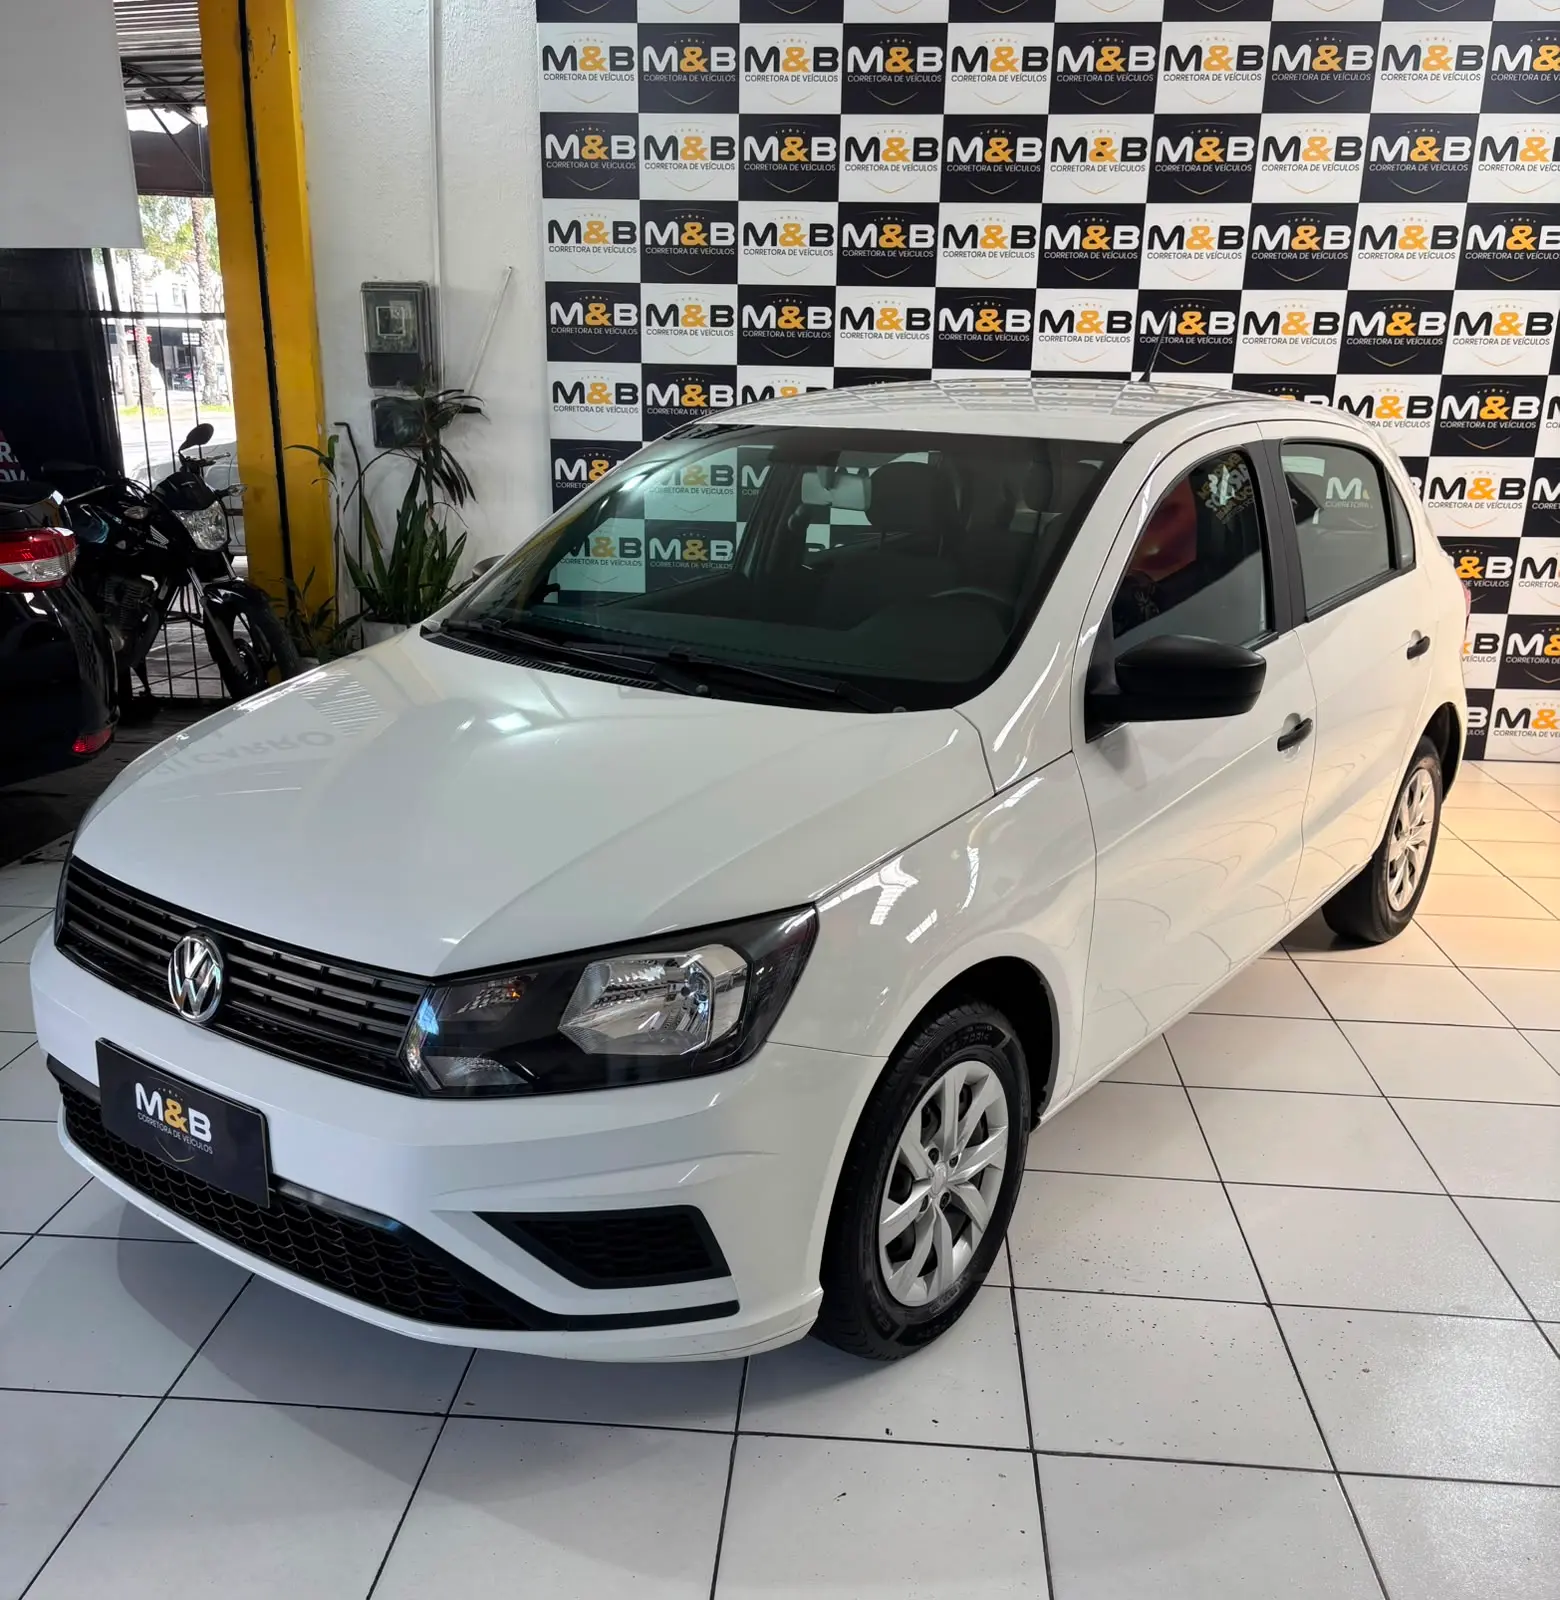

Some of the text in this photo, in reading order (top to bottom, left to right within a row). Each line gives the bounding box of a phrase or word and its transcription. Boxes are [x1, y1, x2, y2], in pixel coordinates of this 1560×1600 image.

[542, 45, 635, 72] M&B
[643, 45, 736, 72] M&B
[745, 46, 839, 72] M&B
[848, 46, 944, 73] M&B
[952, 45, 1050, 73] M&B
[1057, 45, 1157, 72] M&B
[1164, 44, 1265, 72] M&B
[1272, 44, 1375, 72] M&B
[1381, 43, 1486, 72] M&B
[600, 73, 635, 81] VEÍCULOS
[802, 74, 838, 82] VEÍCULOS
[1010, 74, 1048, 82] VEÍCULOS
[1224, 72, 1262, 81] VEÍCULOS
[1332, 72, 1371, 81] VEÍCULOS
[1442, 72, 1482, 81] VEÍCULOS
[545, 134, 636, 160] M&B
[644, 135, 735, 161] M&B
[744, 136, 837, 162] M&B
[845, 136, 940, 163] M&B
[947, 136, 1043, 162] M&B
[1050, 136, 1148, 163] M&B
[1156, 136, 1256, 162] M&B
[1262, 135, 1364, 162] M&B
[1370, 135, 1473, 162] M&B
[700, 162, 735, 170] VEÍCULOS
[902, 163, 938, 172] VEÍCULOS
[1109, 164, 1146, 172] VEÍCULOS
[1215, 163, 1253, 171] VEÍCULOS
[1322, 163, 1360, 171] VEÍCULOS
[1430, 163, 1469, 171] VEÍCULOS
[548, 219, 637, 245] M&B
[645, 221, 735, 247] M&B
[743, 221, 834, 247] M&B
[843, 223, 935, 249] M&B
[943, 223, 1038, 249] M&B
[1044, 224, 1141, 250] M&B
[1147, 225, 1246, 250] M&B
[1253, 224, 1353, 250] M&B
[1359, 224, 1460, 250] M&B
[603, 246, 637, 254] VEÍCULOS
[799, 248, 834, 256] VEÍCULOS
[1000, 250, 1036, 258] VEÍCULOS
[1205, 251, 1242, 259] VEÍCULOS
[1311, 251, 1349, 259] VEÍCULOS
[1418, 251, 1456, 259] VEÍCULOS
[550, 301, 638, 327] M&B
[646, 303, 734, 328] M&B
[742, 304, 832, 330] M&B
[840, 306, 932, 332] M&B
[939, 307, 1032, 333] M&B
[1039, 309, 1133, 334] M&B
[1140, 310, 1237, 335] M&B
[1243, 311, 1341, 336] M&B
[1347, 311, 1447, 336] M&B
[1454, 311, 1556, 336] M&B
[700, 329, 734, 337] VEÍCULOS
[895, 332, 930, 340] VEÍCULOS
[994, 333, 1030, 342] VEÍCULOS
[1095, 335, 1131, 343] VEÍCULOS
[1300, 337, 1338, 345] VEÍCULOS
[1405, 337, 1443, 345] VEÍCULOS
[1512, 337, 1551, 345] VEÍCULOS
[553, 380, 639, 406] M&B
[647, 382, 734, 408] M&B
[606, 406, 638, 414] VEÍCULOS
[1339, 394, 1435, 419] M&B
[1441, 395, 1541, 420] M&B
[1499, 420, 1537, 428] VEÍCULOS
[1429, 477, 1528, 501] M&B
[650, 537, 733, 562] M&B
[135, 1083, 212, 1143] M&B
[138, 1112, 172, 1135] CORRETORA
[172, 1130, 182, 1140] DE
